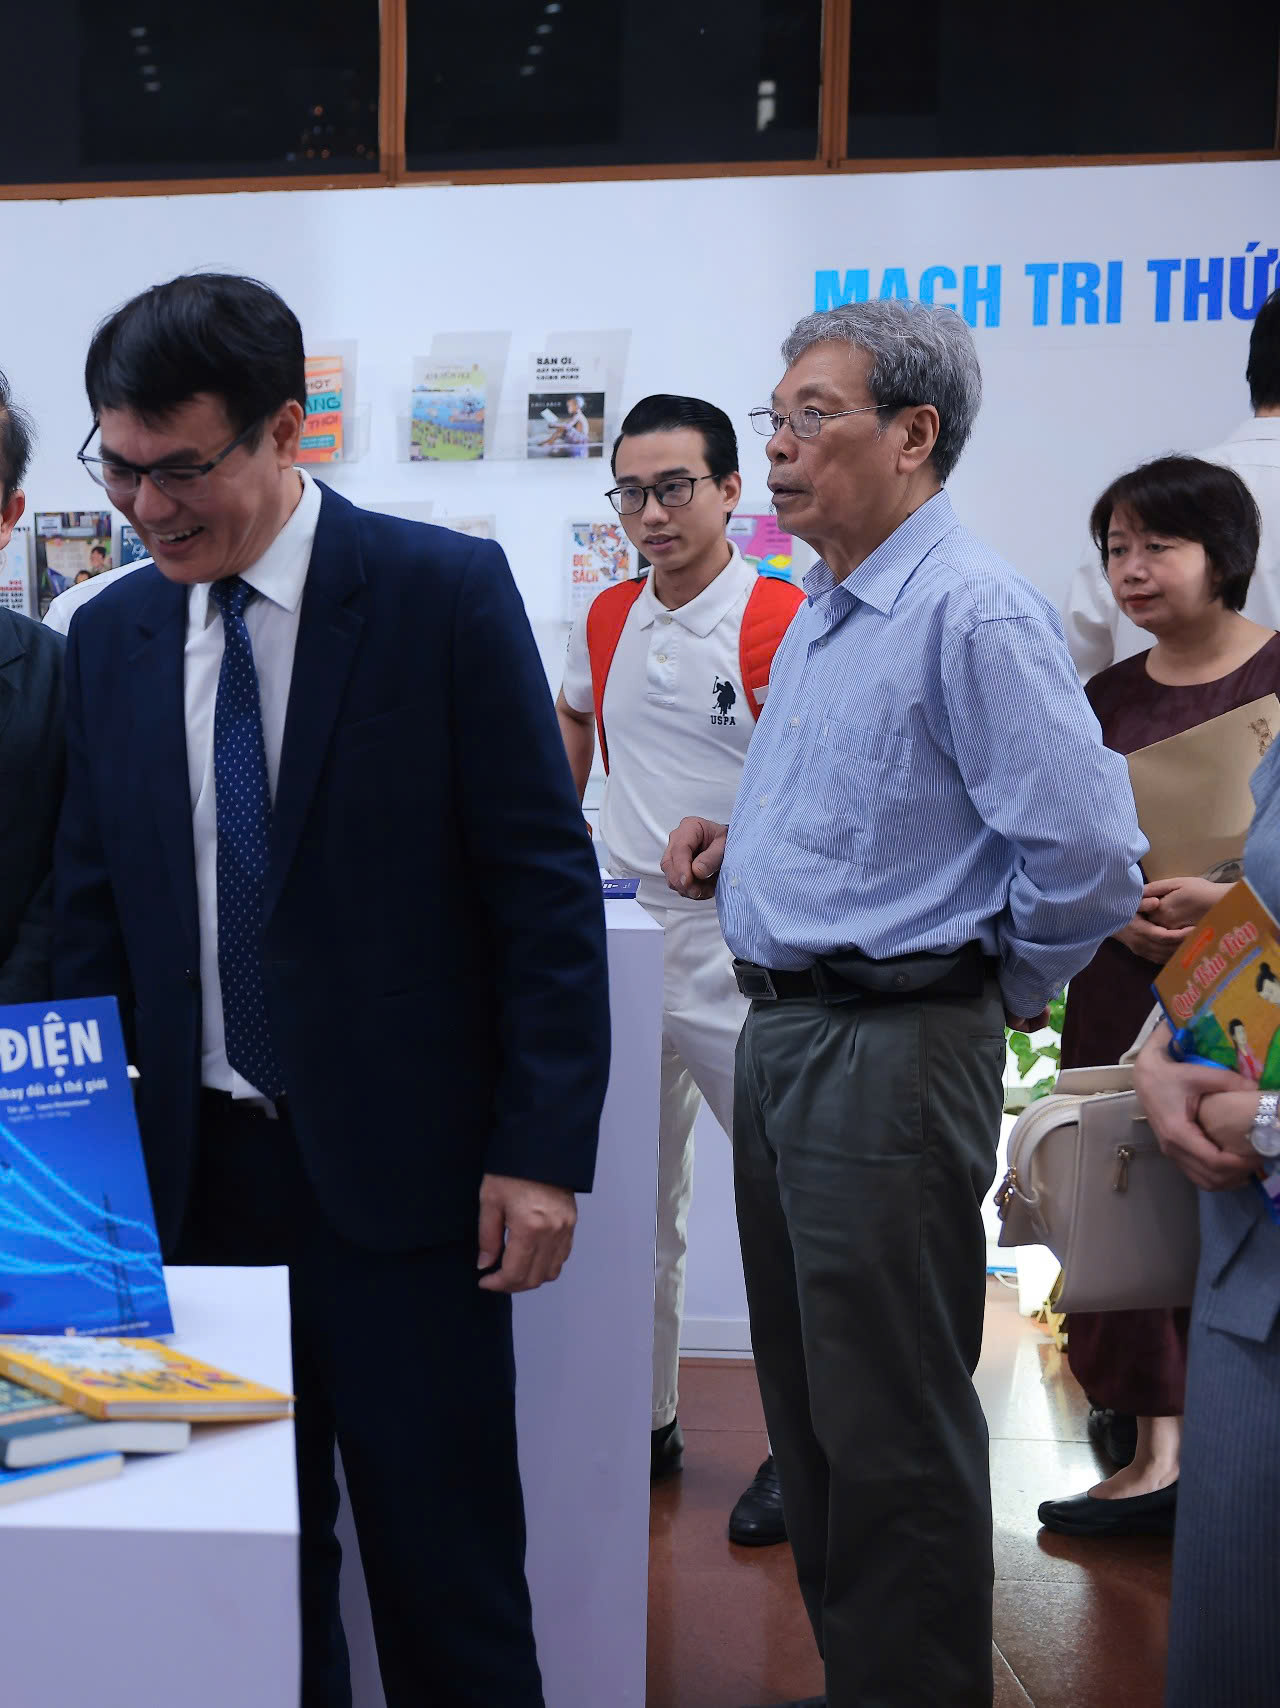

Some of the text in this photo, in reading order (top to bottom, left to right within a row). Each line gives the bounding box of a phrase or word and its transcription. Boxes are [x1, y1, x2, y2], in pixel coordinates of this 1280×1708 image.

[1025, 261, 1123, 326] TRI
[1147, 241, 1280, 322] THỨ
[710, 714, 736, 726] USPA
